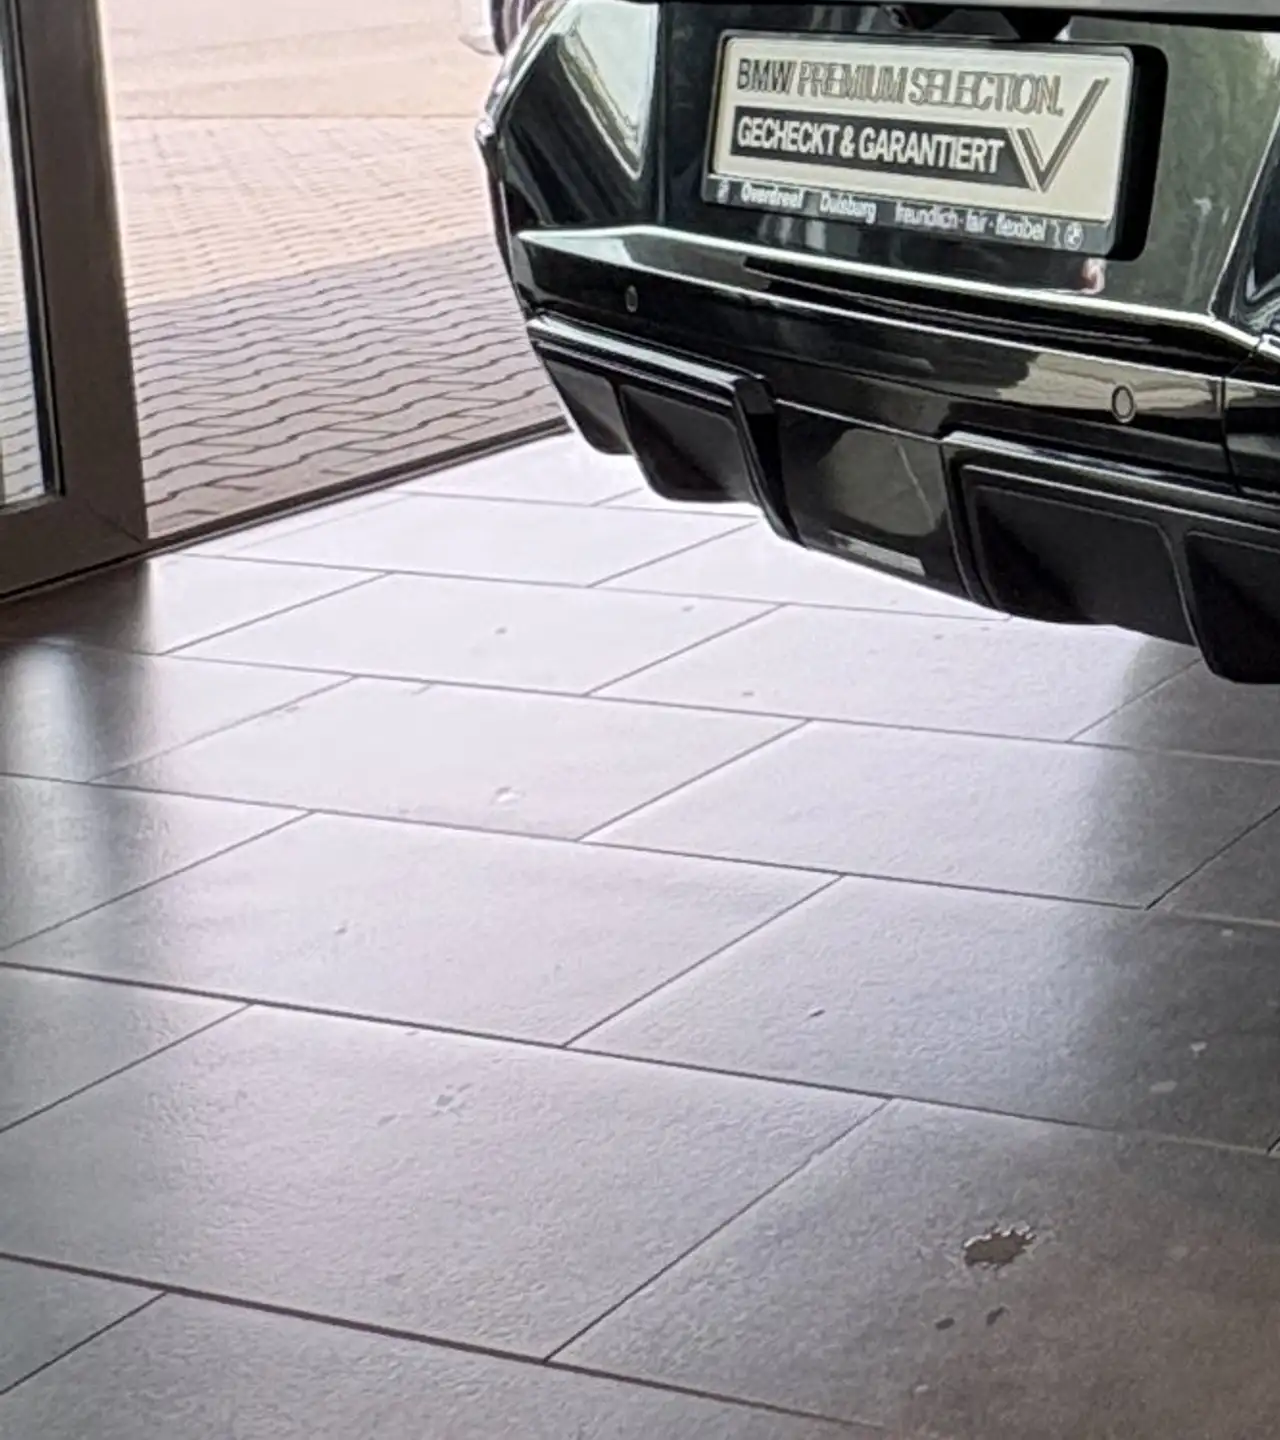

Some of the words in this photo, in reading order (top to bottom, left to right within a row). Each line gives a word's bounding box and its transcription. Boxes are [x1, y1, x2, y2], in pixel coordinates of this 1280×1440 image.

[736, 57, 795, 97] BMW
[797, 60, 909, 105] PREMIUM
[737, 115, 840, 157] GECHECKT
[839, 124, 856, 159] &
[858, 126, 1006, 174] GARANTIERT
